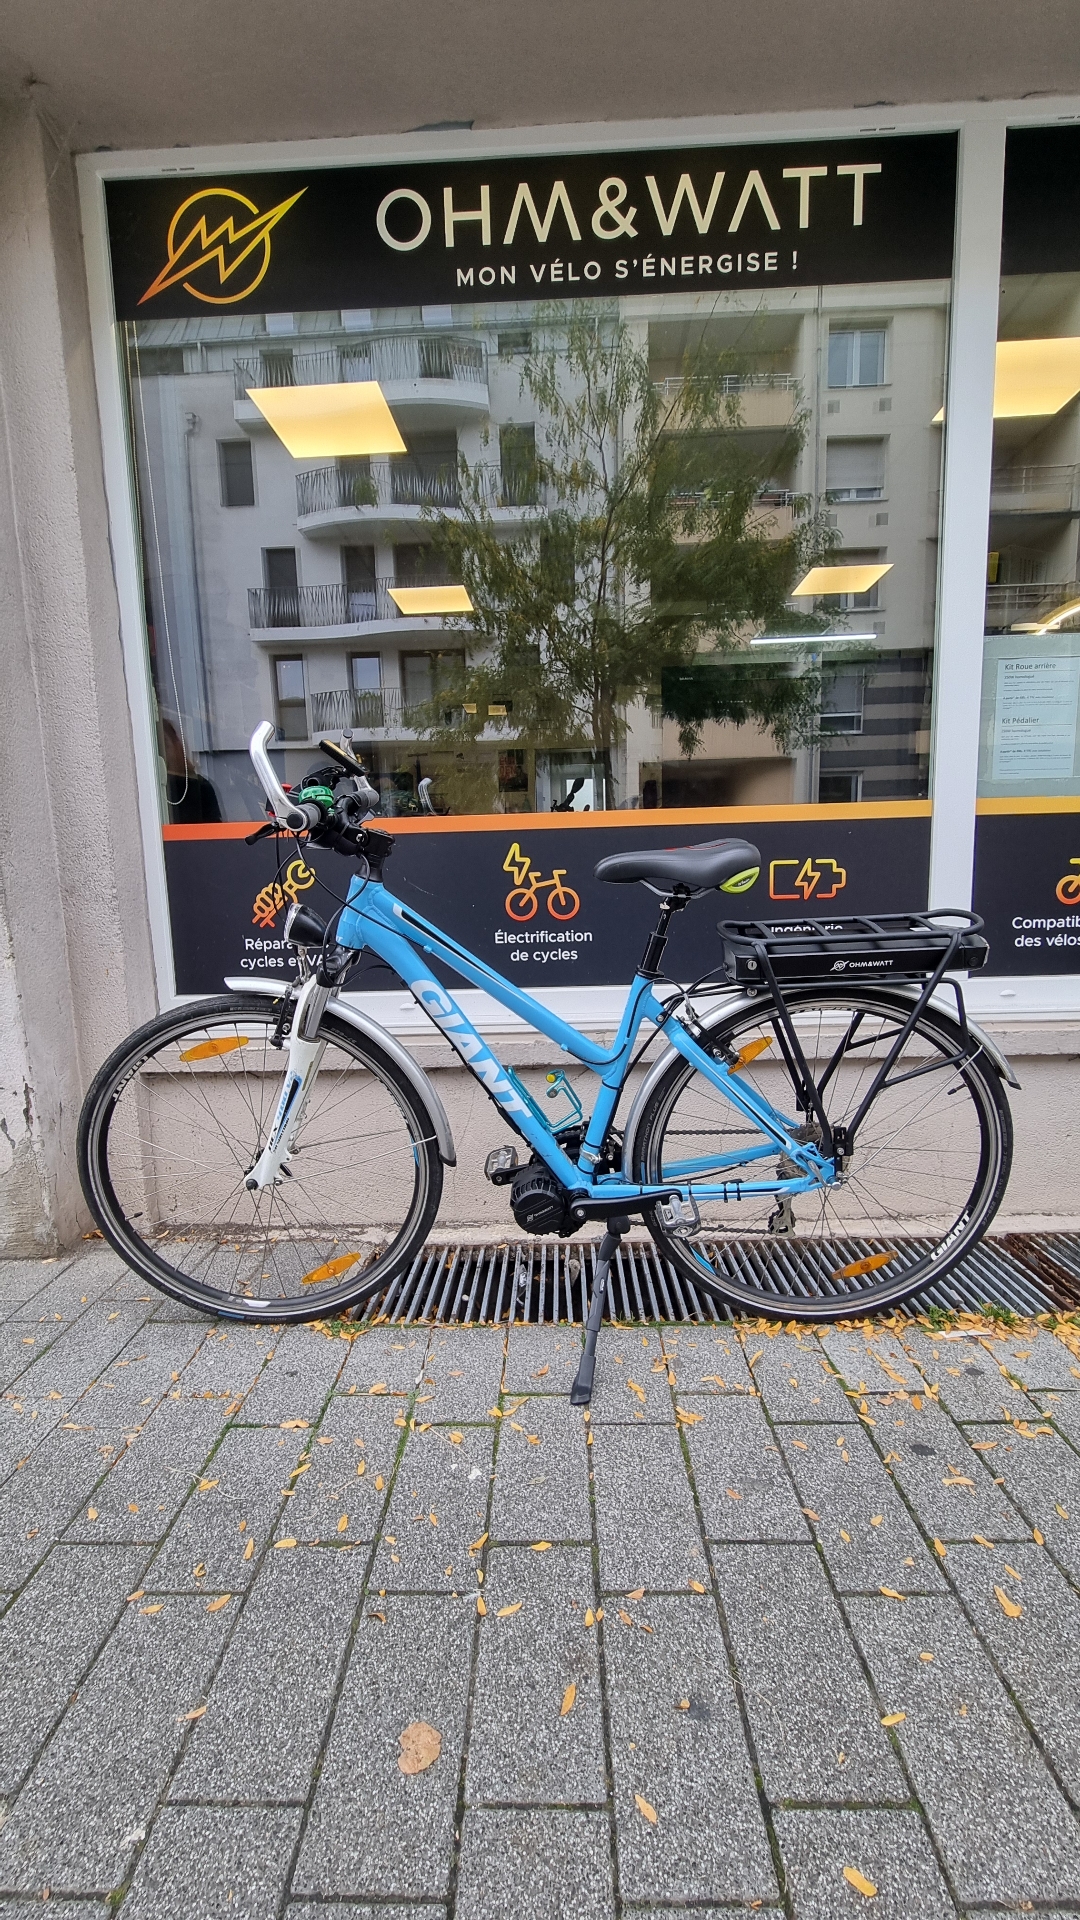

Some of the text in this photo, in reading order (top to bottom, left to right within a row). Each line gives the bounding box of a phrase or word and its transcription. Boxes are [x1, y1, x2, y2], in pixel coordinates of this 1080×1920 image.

[376, 163, 882, 252] OHM&WATT
[456, 265, 516, 287] MON
[530, 258, 602, 283] VÉLO
[791, 250, 798, 270] !
[494, 929, 593, 944] Électrification
[1014, 934, 1042, 947] des
[240, 955, 284, 970] cycles
[288, 956, 299, 967] e
[510, 948, 578, 963] de cycles
[848, 959, 894, 968] OHM&WATT
[410, 979, 533, 1120] GIANT
[112, 1055, 148, 1102] GIANT
[930, 1210, 970, 1261] GIANT
